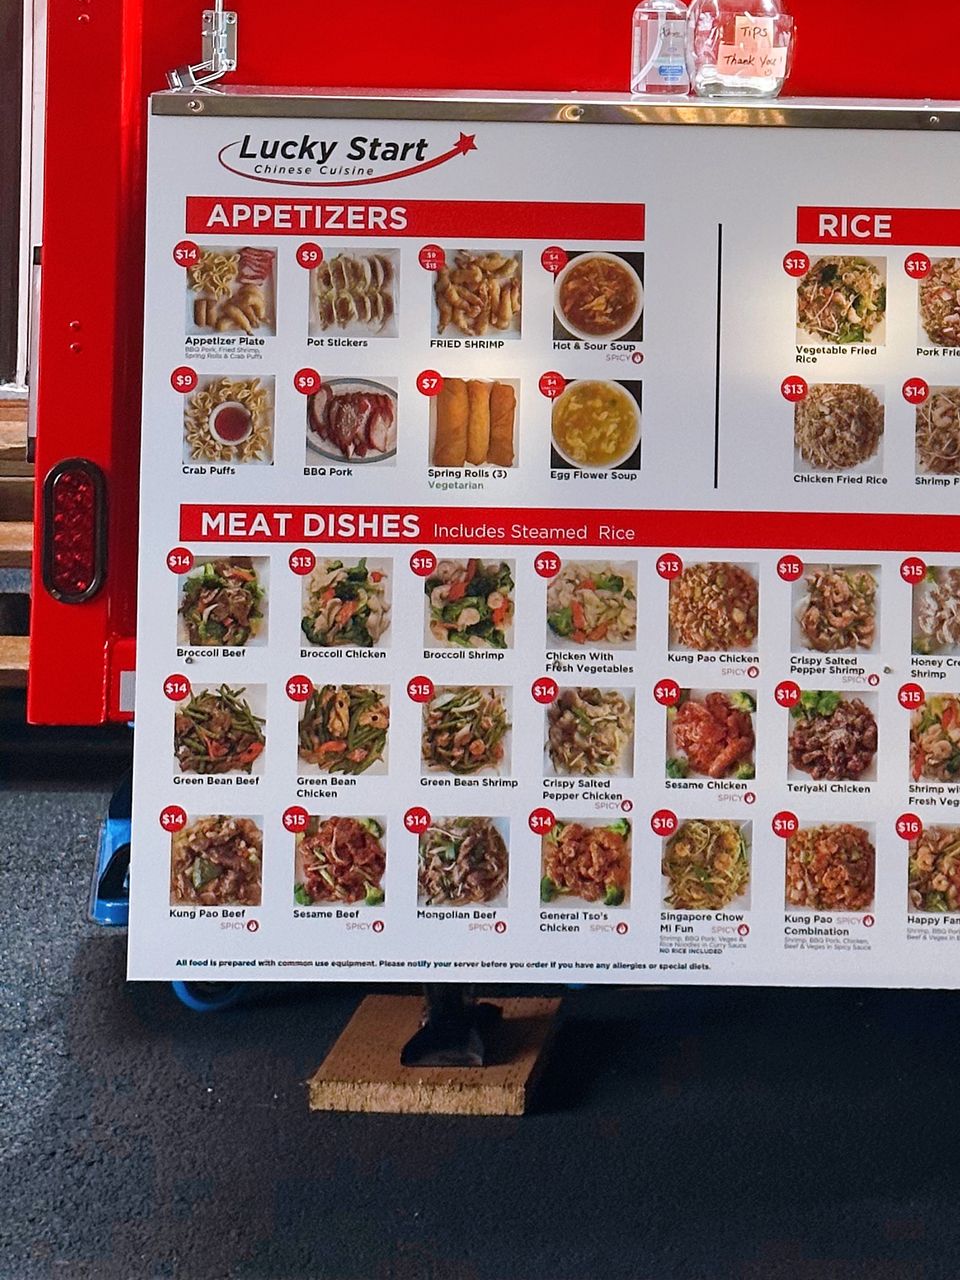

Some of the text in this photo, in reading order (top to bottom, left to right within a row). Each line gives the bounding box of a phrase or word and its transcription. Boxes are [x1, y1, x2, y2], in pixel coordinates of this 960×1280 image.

[724, 56, 755, 65] Thank
[239, 135, 428, 164] Lucky Start
[254, 165, 374, 177] Chinese Cuisine
[207, 204, 407, 230] APPETIZERS
[819, 213, 891, 237] RICE
[175, 248, 197, 260] $14
[302, 250, 318, 263] $9
[786, 258, 806, 270] $13
[185, 337, 265, 346] Appetizer Plate
[307, 338, 368, 347] Pot Stickers
[431, 340, 461, 348] FRIED
[553, 341, 637, 354] Hot & Sour Soup
[917, 348, 939, 356] Pork
[606, 354, 631, 362] SPICY
[183, 466, 235, 475] Crab Puffs
[551, 470, 639, 481] Egg Flower Soup
[428, 481, 484, 491] Vegetarian
[202, 512, 420, 537] MEAT DISHES
[435, 524, 635, 540] Includes Steamed Rice
[169, 555, 190, 567] $14
[658, 560, 679, 572] $13
[779, 562, 800, 575] $15
[301, 648, 386, 658] Broccoli Chicken
[668, 654, 759, 664] Kung Pao Chicken
[722, 667, 748, 677] SPICY
[787, 784, 870, 794] Teriyaki Chicken
[653, 817, 675, 829] $16
[417, 911, 496, 920] Mongolian Beef
[540, 912, 608, 920] General Tso's
[908, 916, 940, 926] Happy
[540, 924, 580, 932] Chicken
[407, 960, 431, 968] notify
